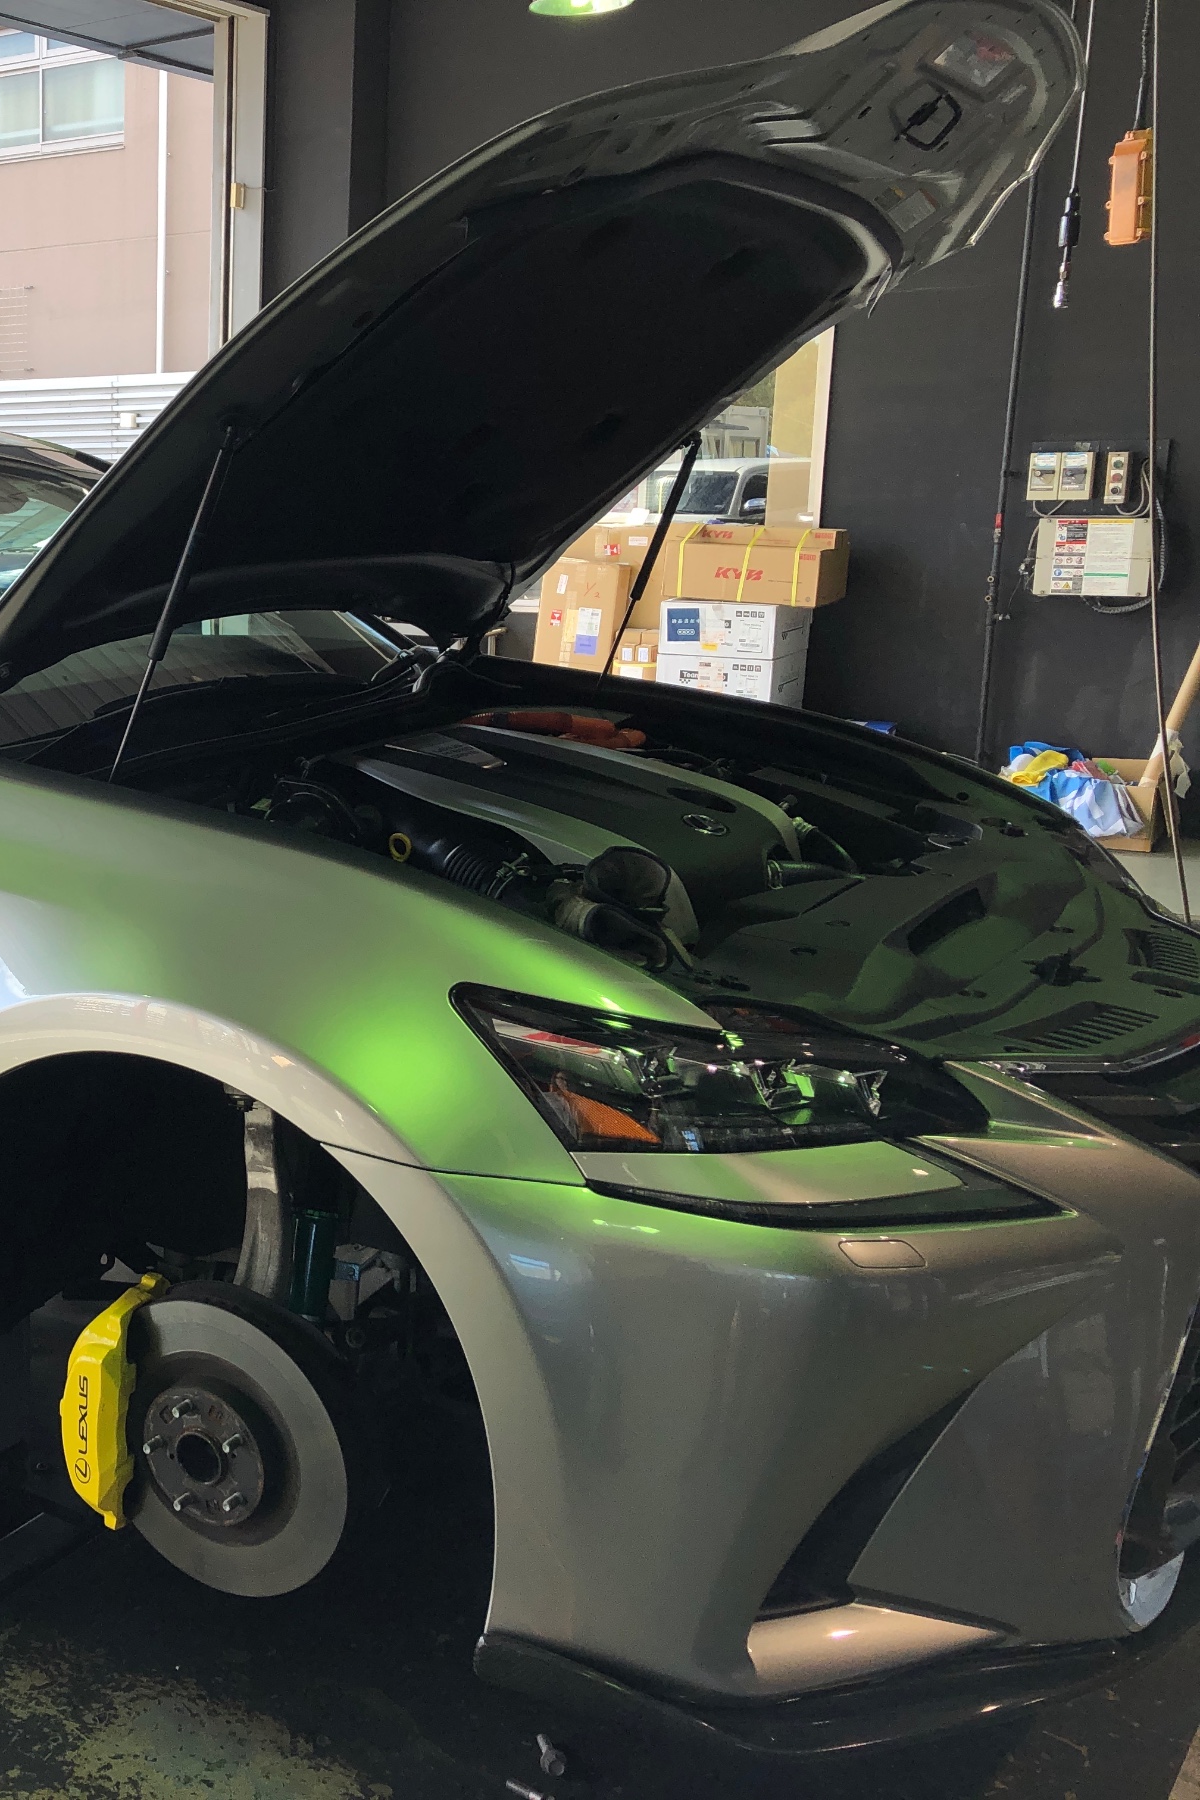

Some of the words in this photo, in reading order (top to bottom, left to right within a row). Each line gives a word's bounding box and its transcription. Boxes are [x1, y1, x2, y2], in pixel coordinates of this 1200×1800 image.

[702, 530, 734, 539] KYB
[714, 566, 764, 581] KYB
[78, 1375, 89, 1455] LEXUS
